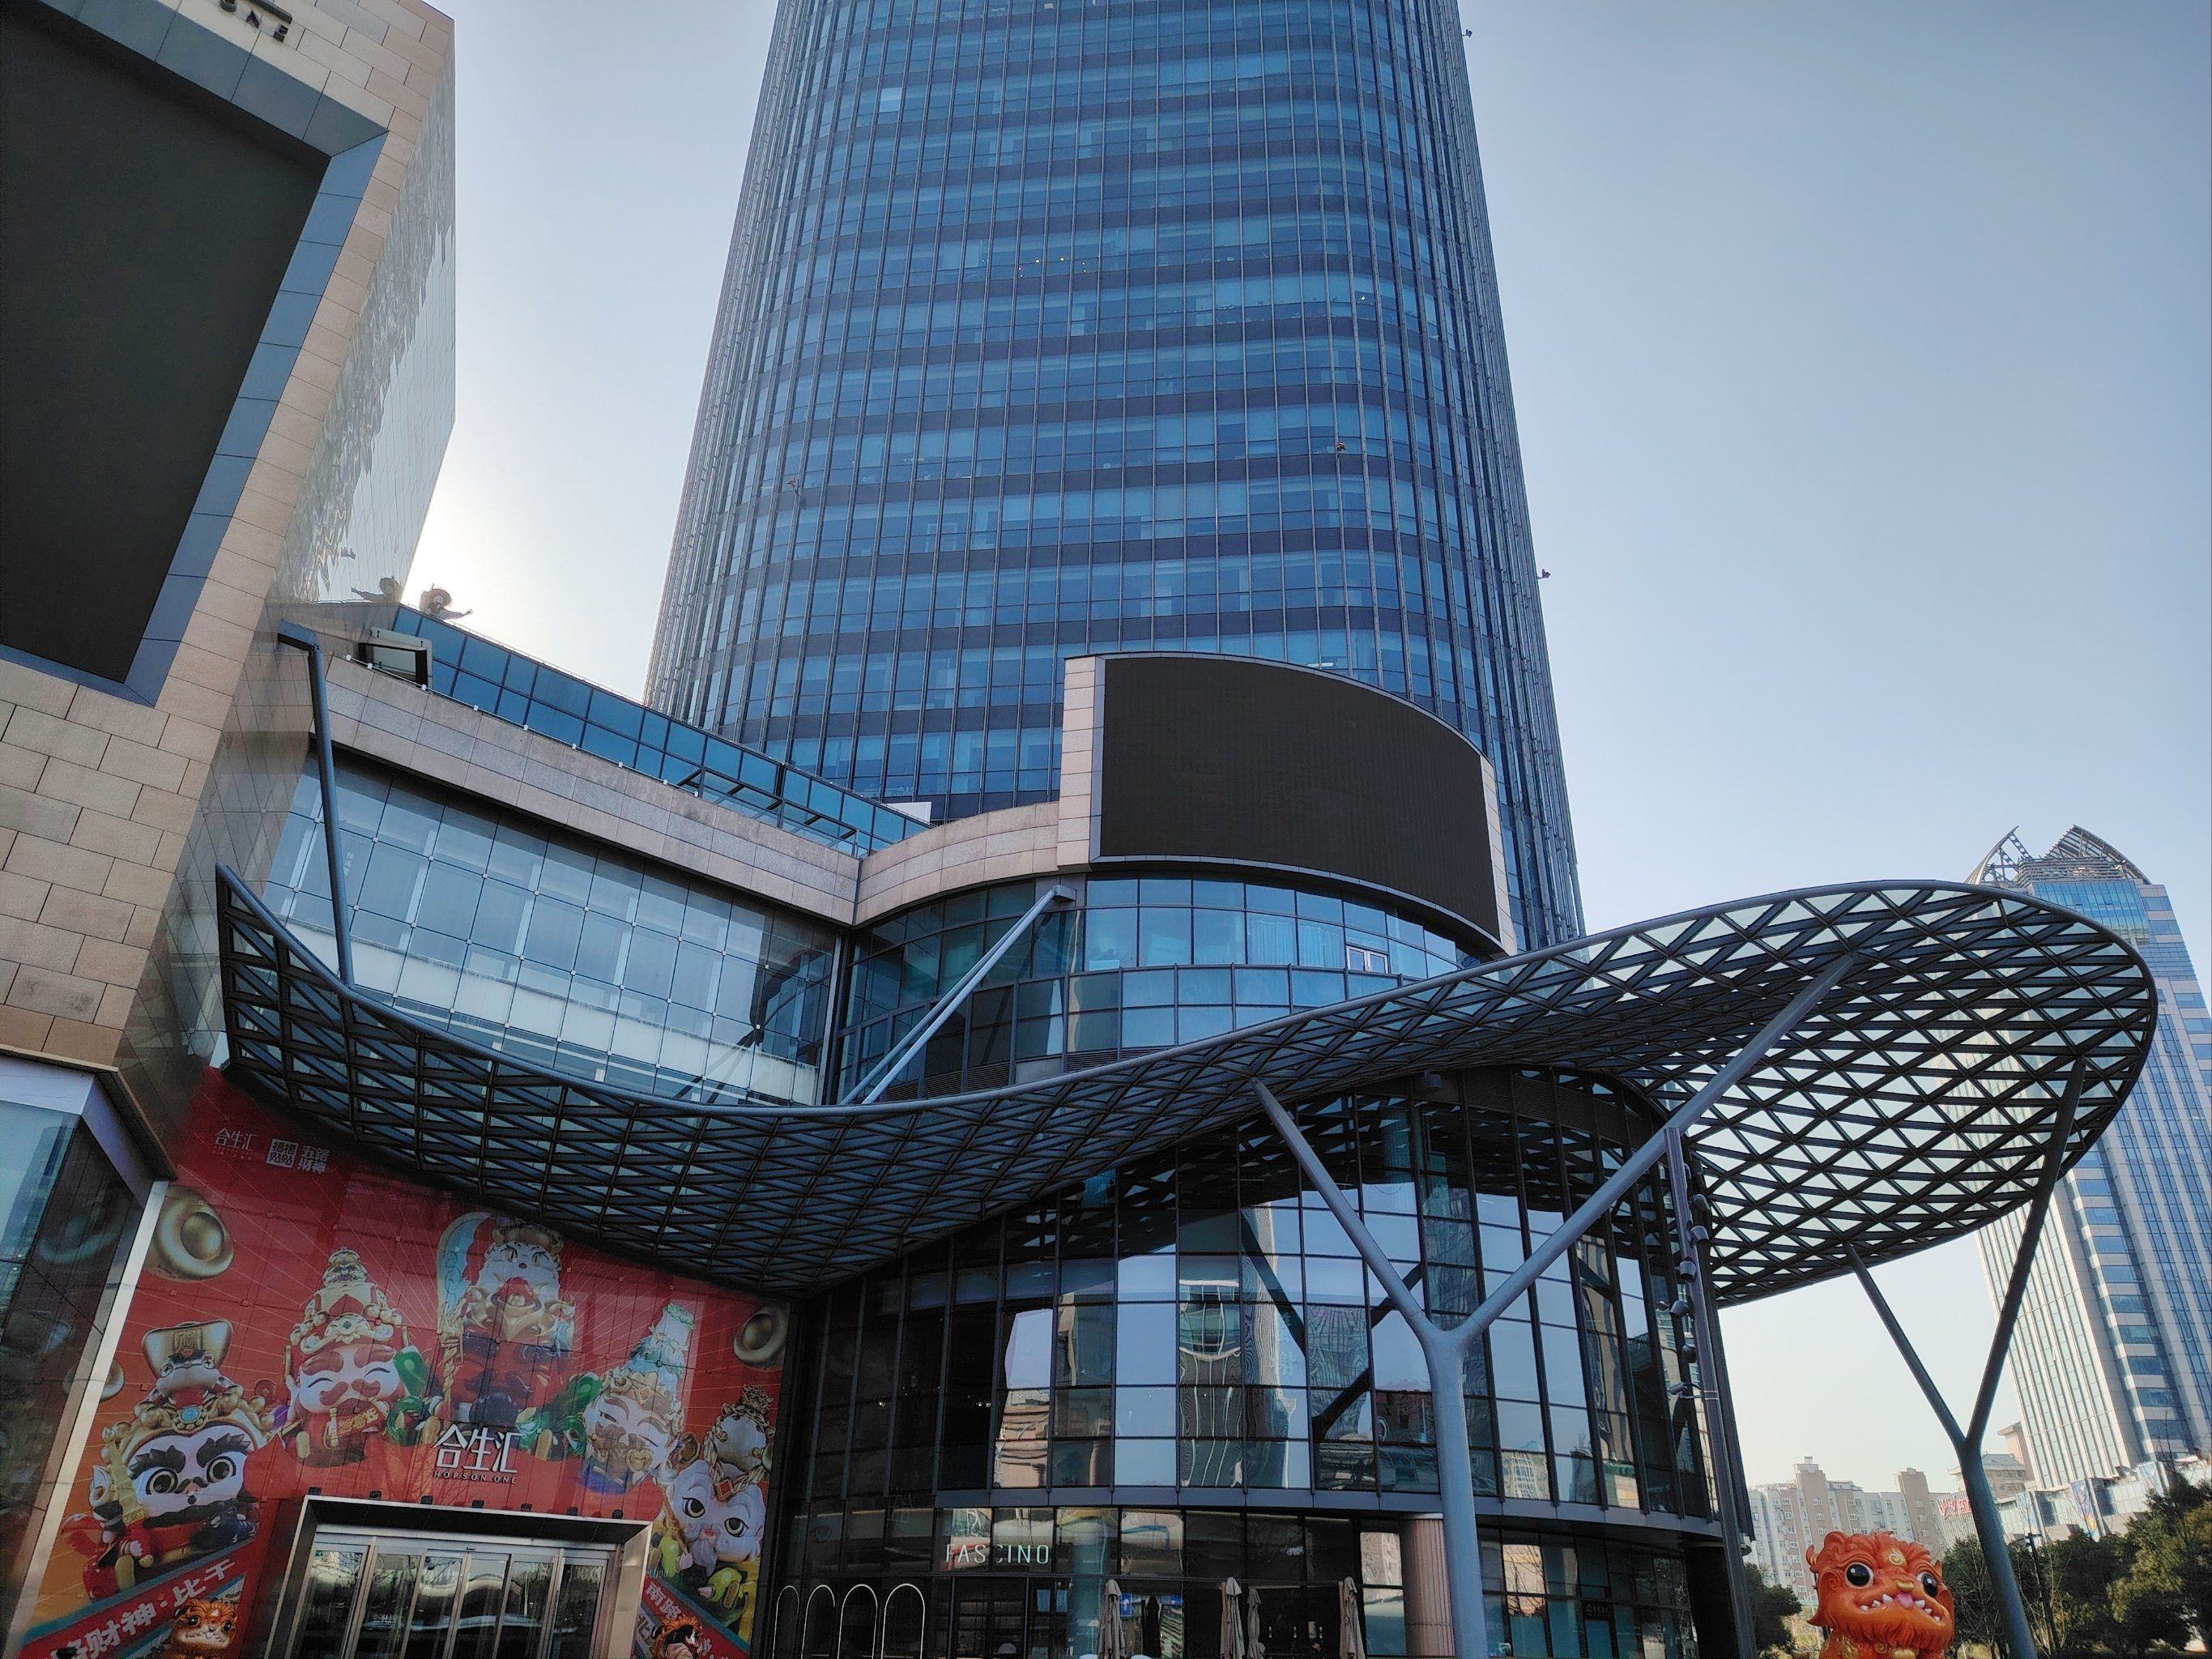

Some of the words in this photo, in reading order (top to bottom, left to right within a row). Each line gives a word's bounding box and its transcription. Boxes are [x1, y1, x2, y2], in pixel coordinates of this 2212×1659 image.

[214, 1128, 258, 1151] 合生汇
[431, 1423, 524, 1473] 合生汇
[433, 1470, 487, 1482] HOPSON
[493, 1475, 518, 1484] ONE
